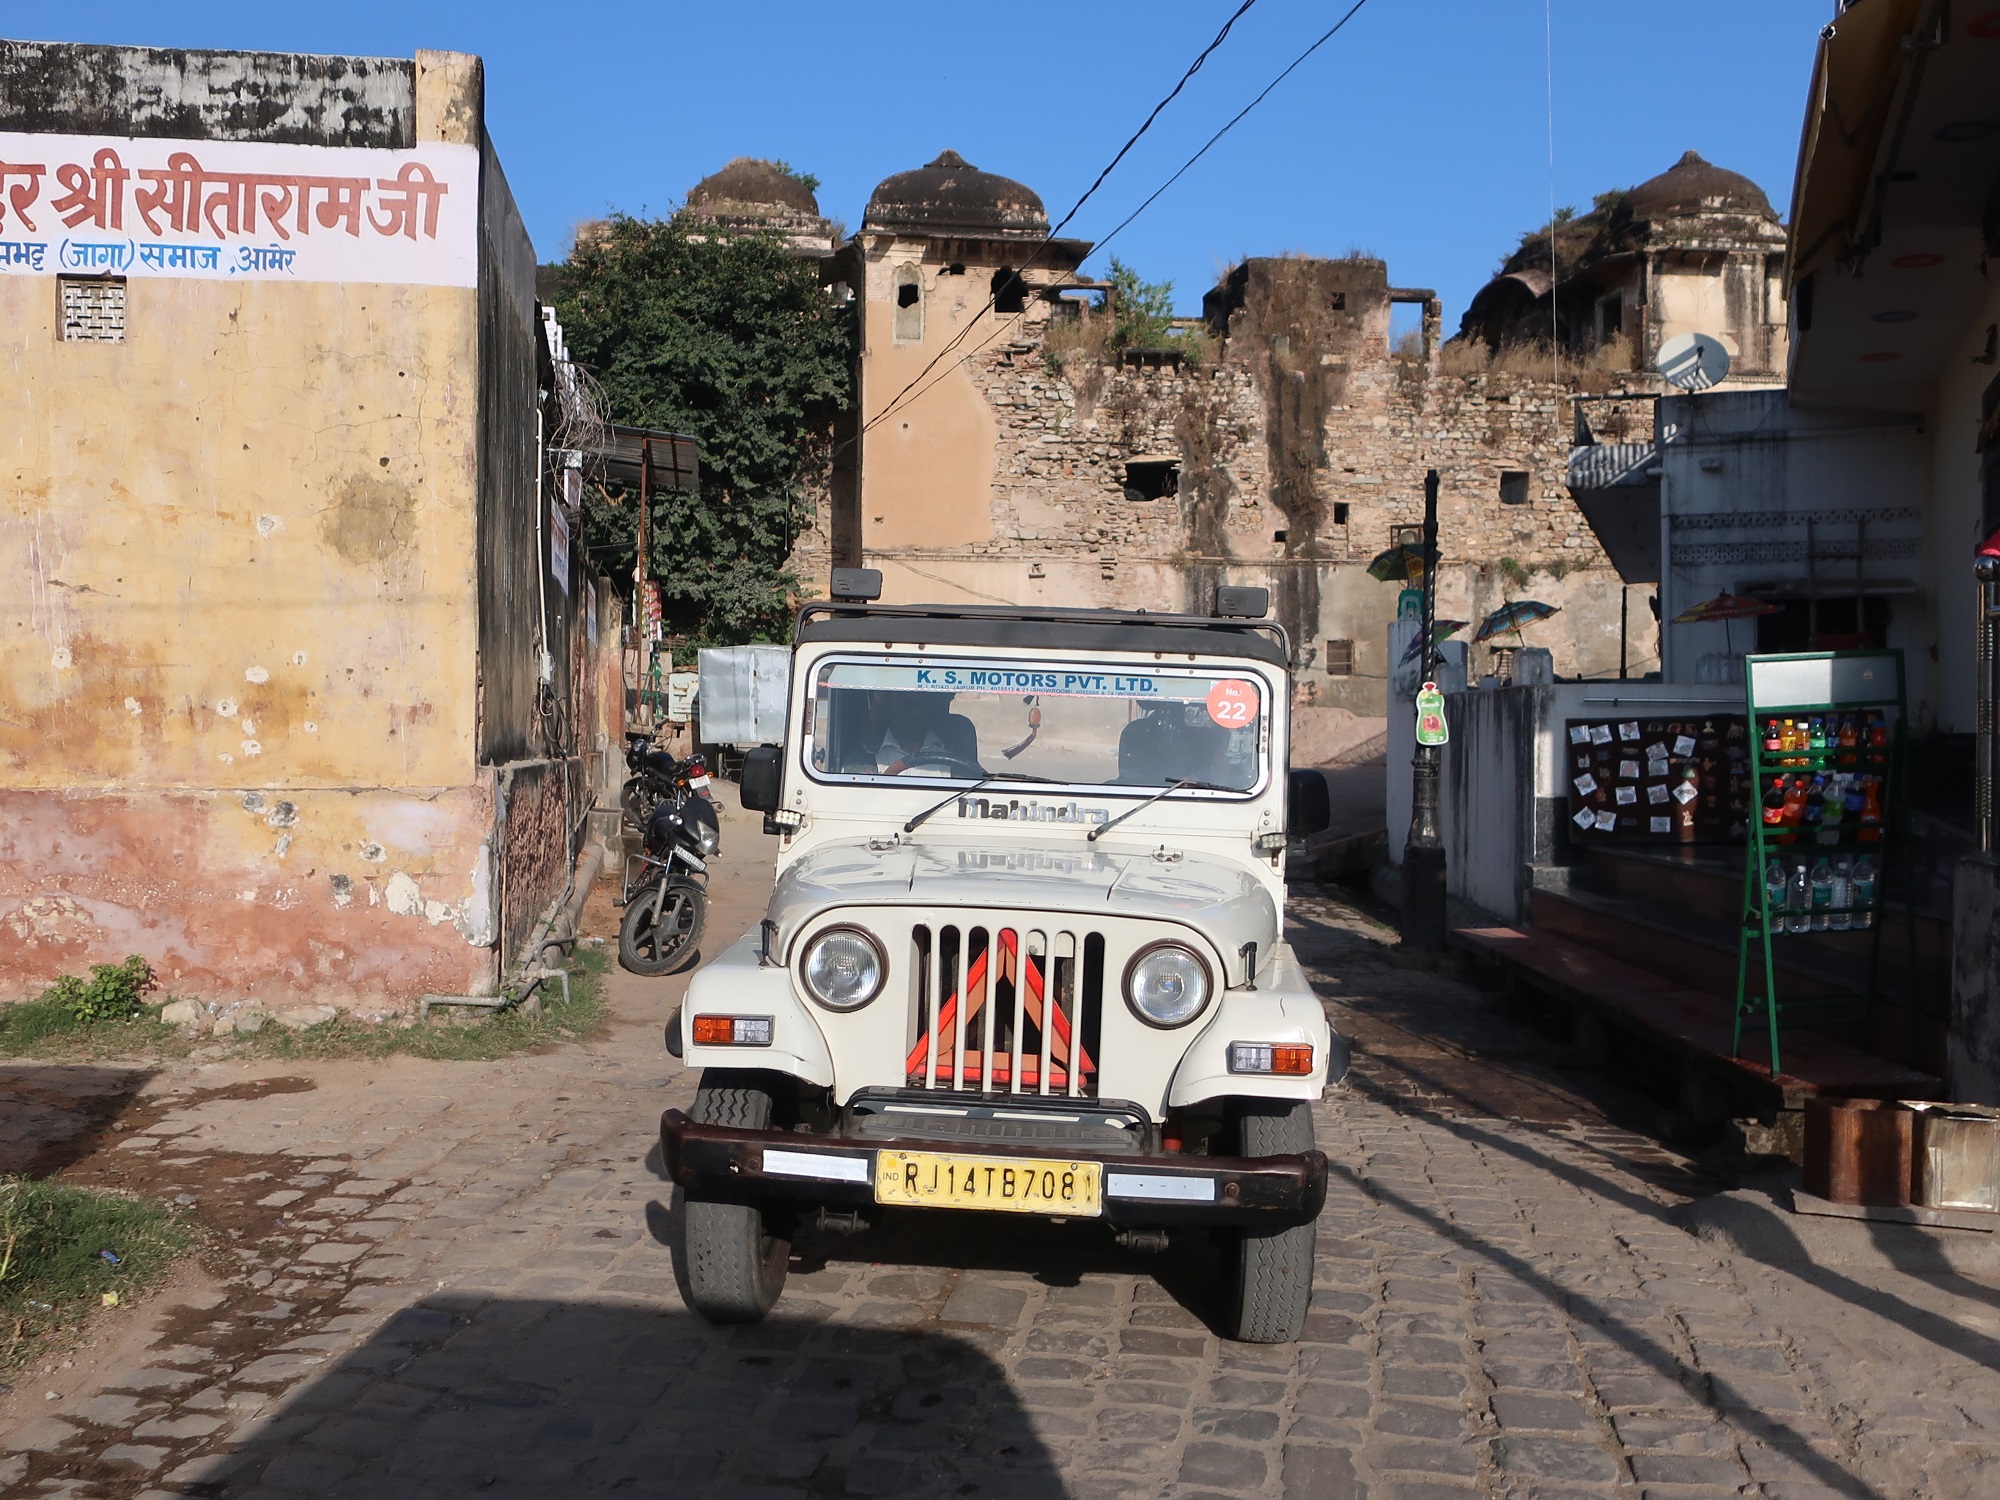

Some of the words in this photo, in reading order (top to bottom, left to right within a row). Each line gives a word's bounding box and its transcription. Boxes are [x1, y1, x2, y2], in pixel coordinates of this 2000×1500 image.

[50, 148, 130, 231] श्री
[60, 238, 135, 272] (जागा)
[140, 243, 222, 272] समाज
[917, 669, 937, 684] K.
[944, 671, 963, 685] S.
[970, 671, 1058, 688] MOTORS
[1064, 675, 1107, 690] PVT.
[1115, 677, 1159, 692] LTD.
[1216, 700, 1247, 721] 22
[882, 1171, 900, 1182] IND
